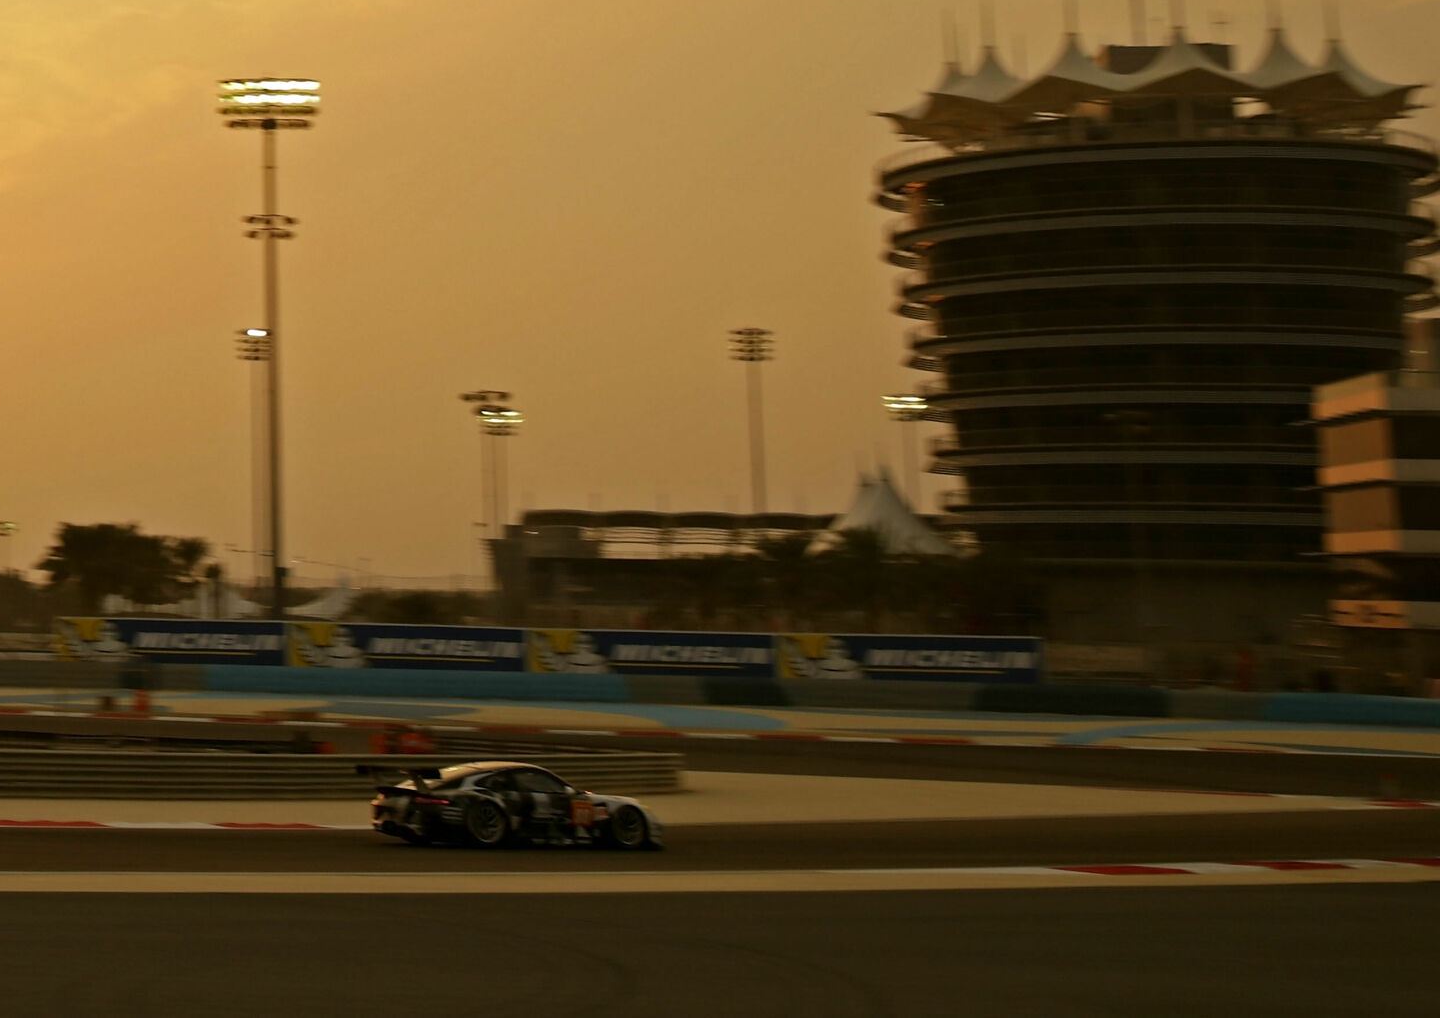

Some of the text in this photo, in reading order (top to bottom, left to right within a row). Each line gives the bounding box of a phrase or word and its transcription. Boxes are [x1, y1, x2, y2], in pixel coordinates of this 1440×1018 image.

[136, 632, 282, 650] MICHELIN
[370, 638, 522, 658] MICHELIN
[614, 644, 769, 664] MICHELIN
[870, 649, 1034, 669] MICHELIN
